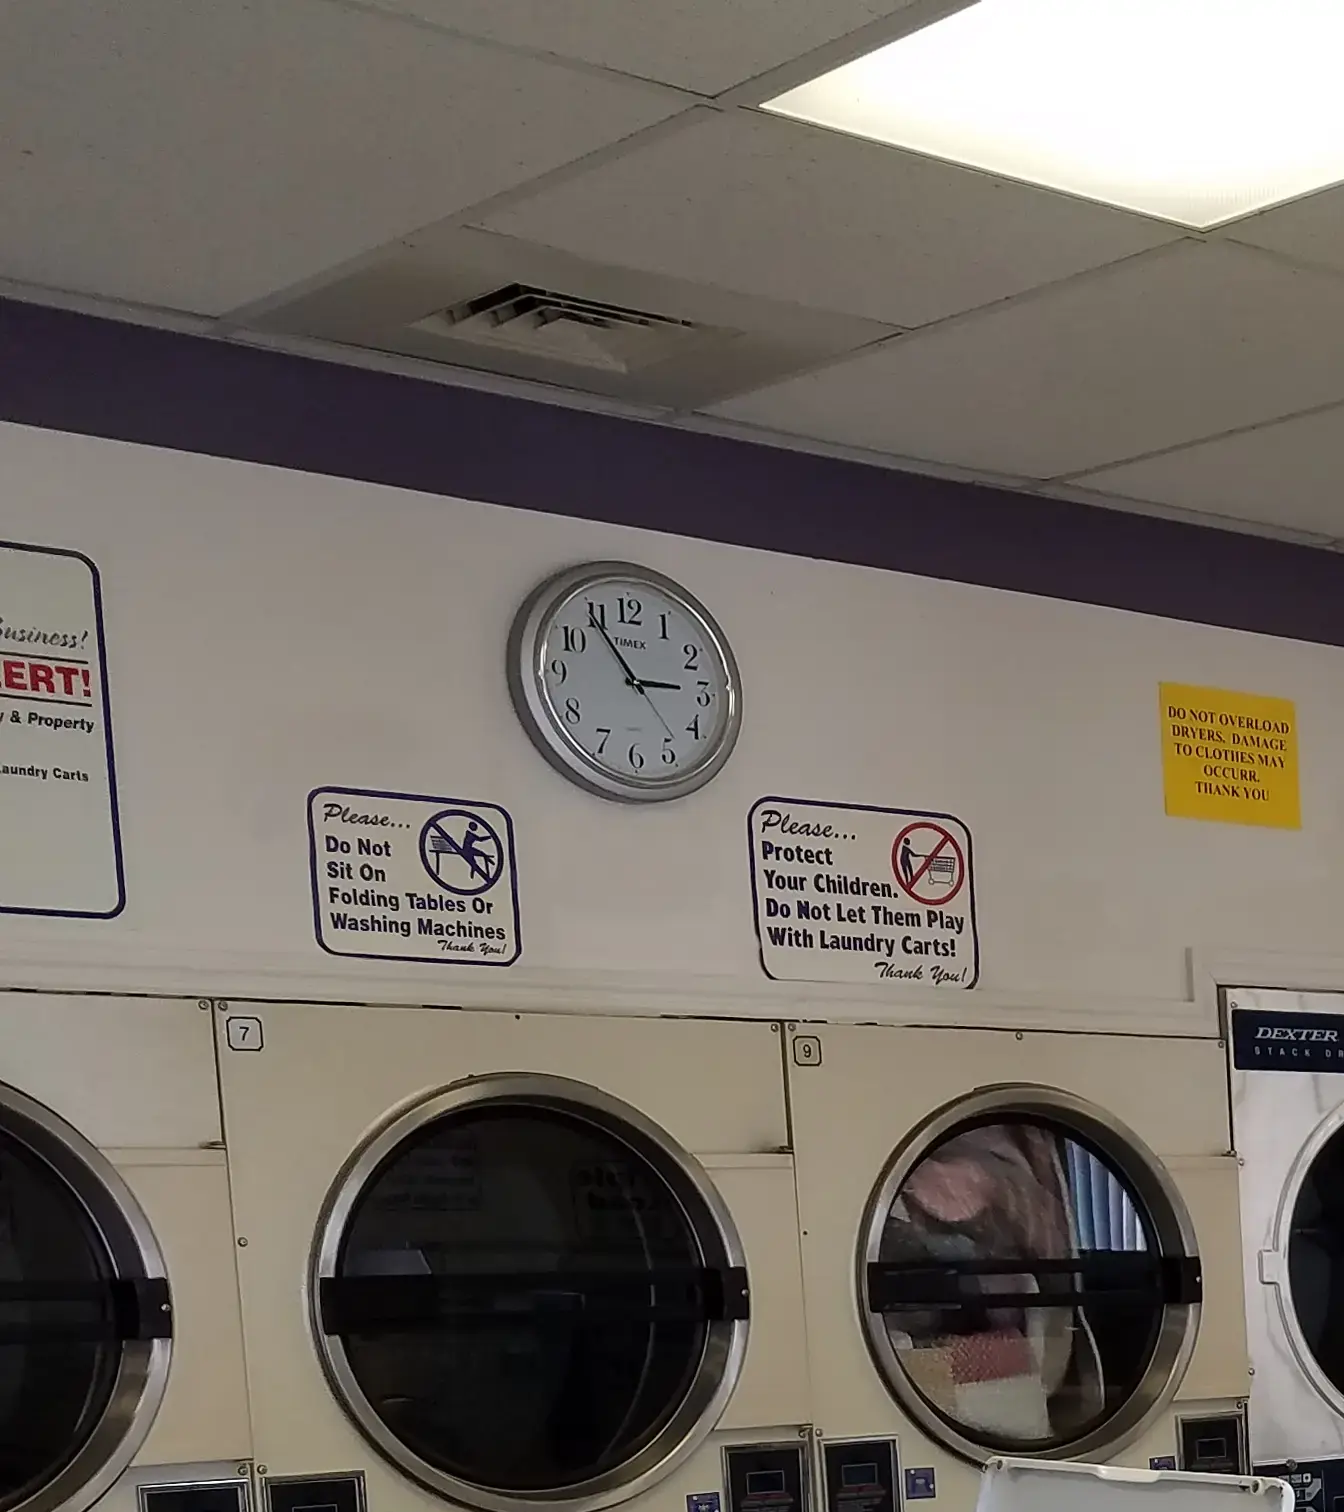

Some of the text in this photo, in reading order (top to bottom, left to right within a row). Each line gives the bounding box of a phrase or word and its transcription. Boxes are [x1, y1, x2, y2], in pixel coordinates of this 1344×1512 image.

[617, 598, 642, 625] 12
[563, 625, 586, 653] 10
[659, 614, 669, 639] 1
[614, 636, 646, 650] TIMEX
[683, 644, 699, 670] 2
[0, 660, 91, 697] ERT!
[551, 660, 567, 684] 9
[697, 681, 710, 706] 3
[10, 711, 21, 723] &
[28, 712, 94, 733] Property
[565, 698, 580, 724] 8
[1168, 706, 1289, 734] DO NOT OVERLOAD
[686, 714, 700, 740] 4
[596, 728, 611, 754] 7
[662, 738, 675, 764] 5
[1232, 733, 1287, 751] DAMAGE
[629, 744, 644, 769] 6
[1174, 742, 1284, 768] TO CLOTHES MAY
[0, 765, 88, 782] aundry Carts
[1195, 781, 1269, 801] THANK YOU
[323, 803, 411, 829] Please...
[761, 810, 856, 840] Please...
[325, 836, 391, 857] Do Not
[762, 841, 833, 865] Protect
[327, 861, 386, 881] Sit On
[763, 869, 898, 898] Your Children.
[329, 887, 494, 914] Folding Tables Or
[330, 912, 506, 940] Washing Machines
[766, 898, 964, 934] Do Not Let Them Play
[438, 940, 507, 955] Thank You!
[767, 927, 956, 957] With Laundry Carts!
[874, 962, 967, 985] Thank You!
[239, 1026, 250, 1041] 7
[1254, 1027, 1339, 1042] DEXTER
[802, 1043, 812, 1059] 9
[1254, 1046, 1311, 1057] STACK
